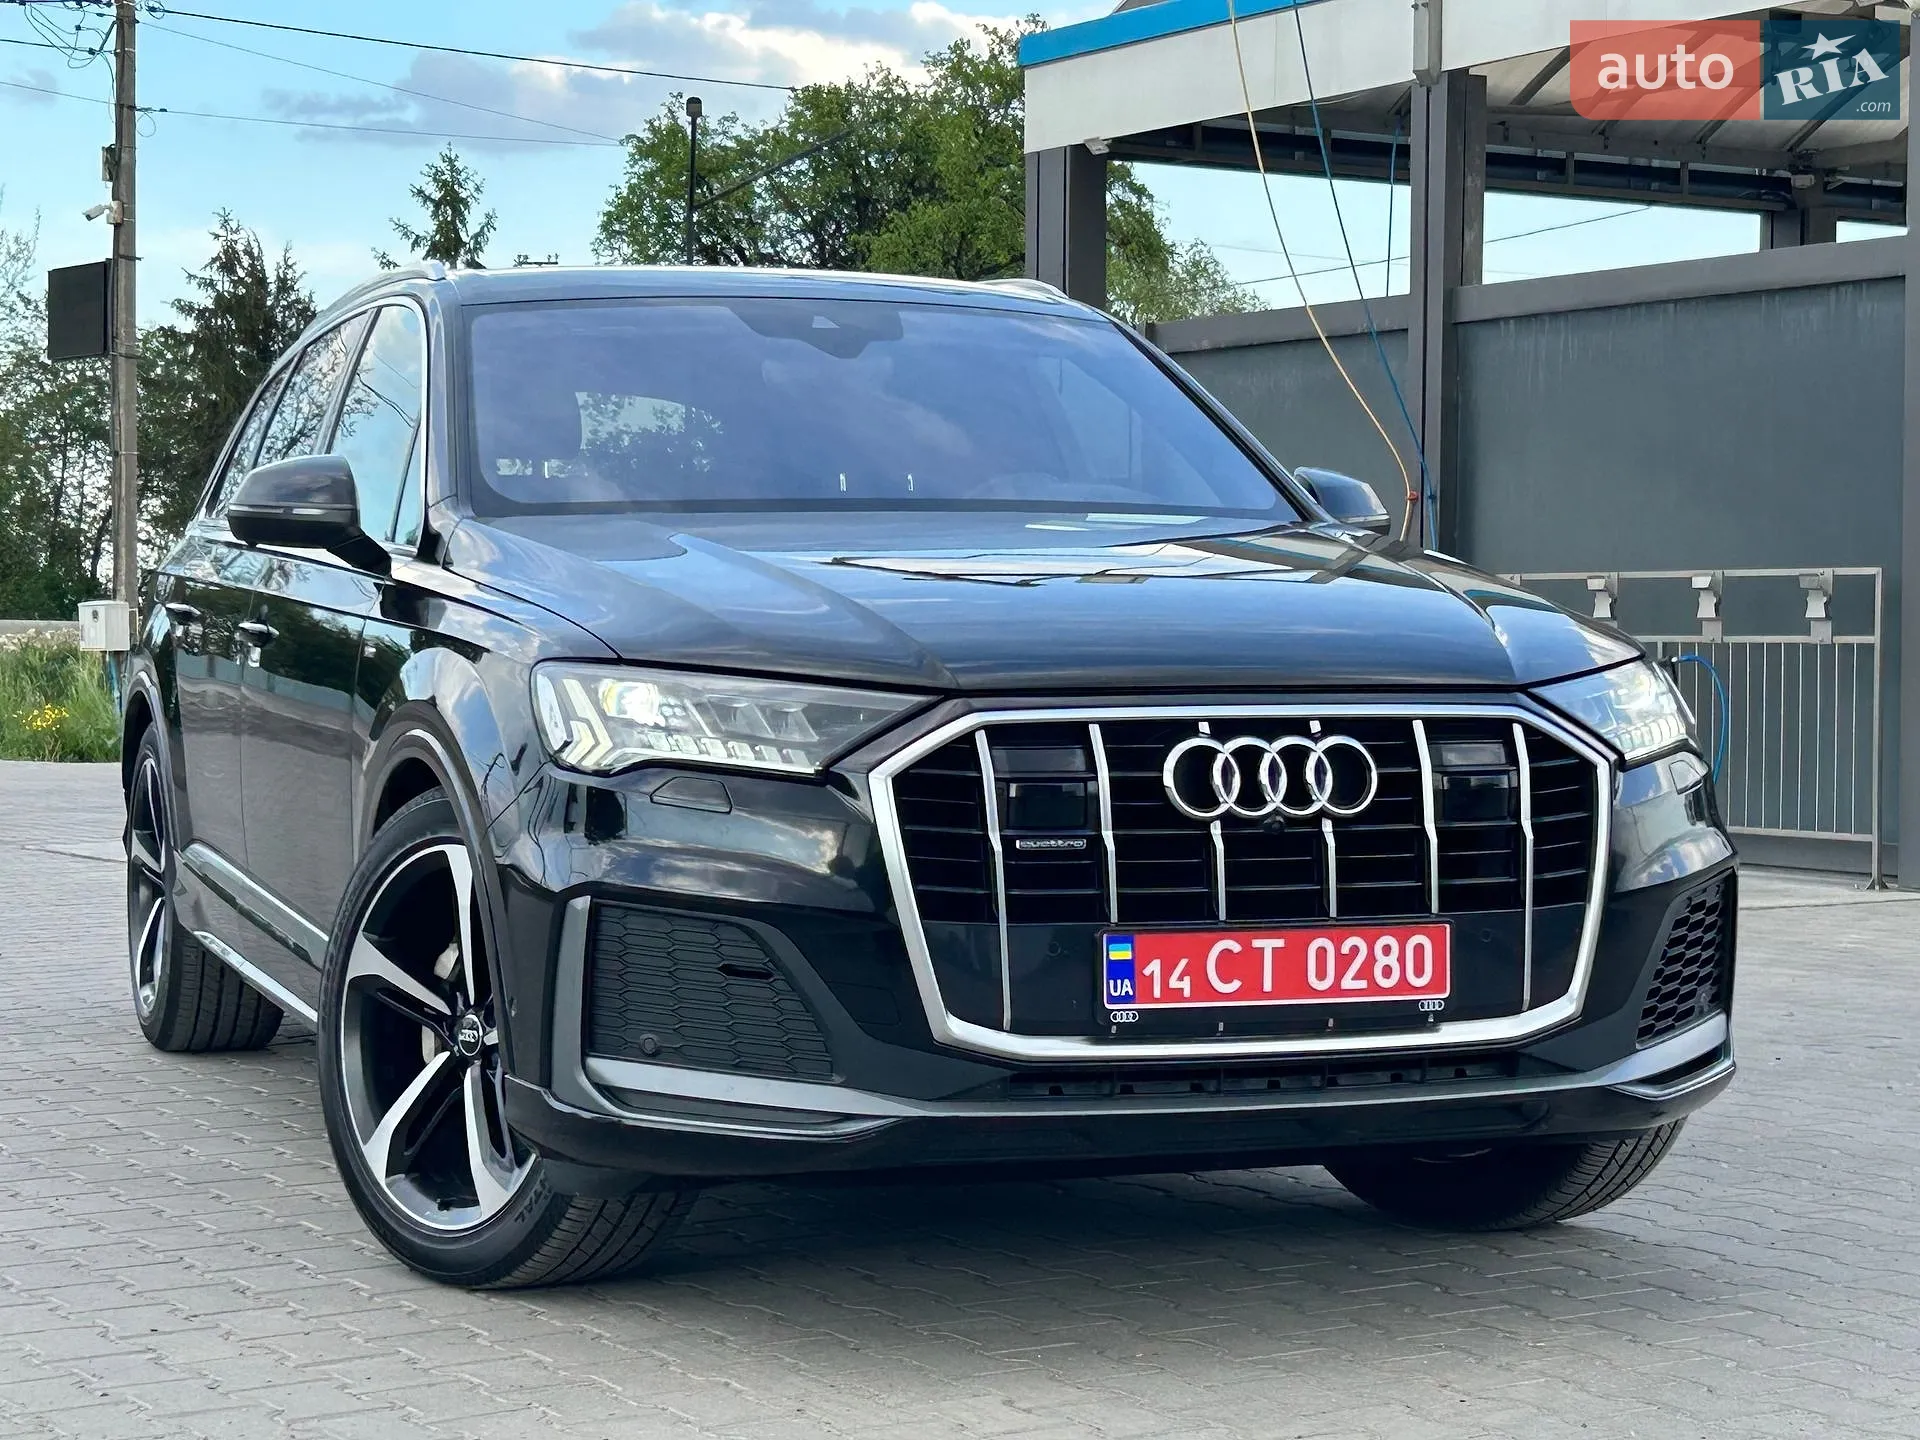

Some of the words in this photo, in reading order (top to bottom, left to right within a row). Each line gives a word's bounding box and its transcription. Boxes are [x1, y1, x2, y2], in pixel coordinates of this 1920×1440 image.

[1142, 958, 1191, 998] 14
[1306, 934, 1433, 991] 0280
[1108, 979, 1134, 997] UA
